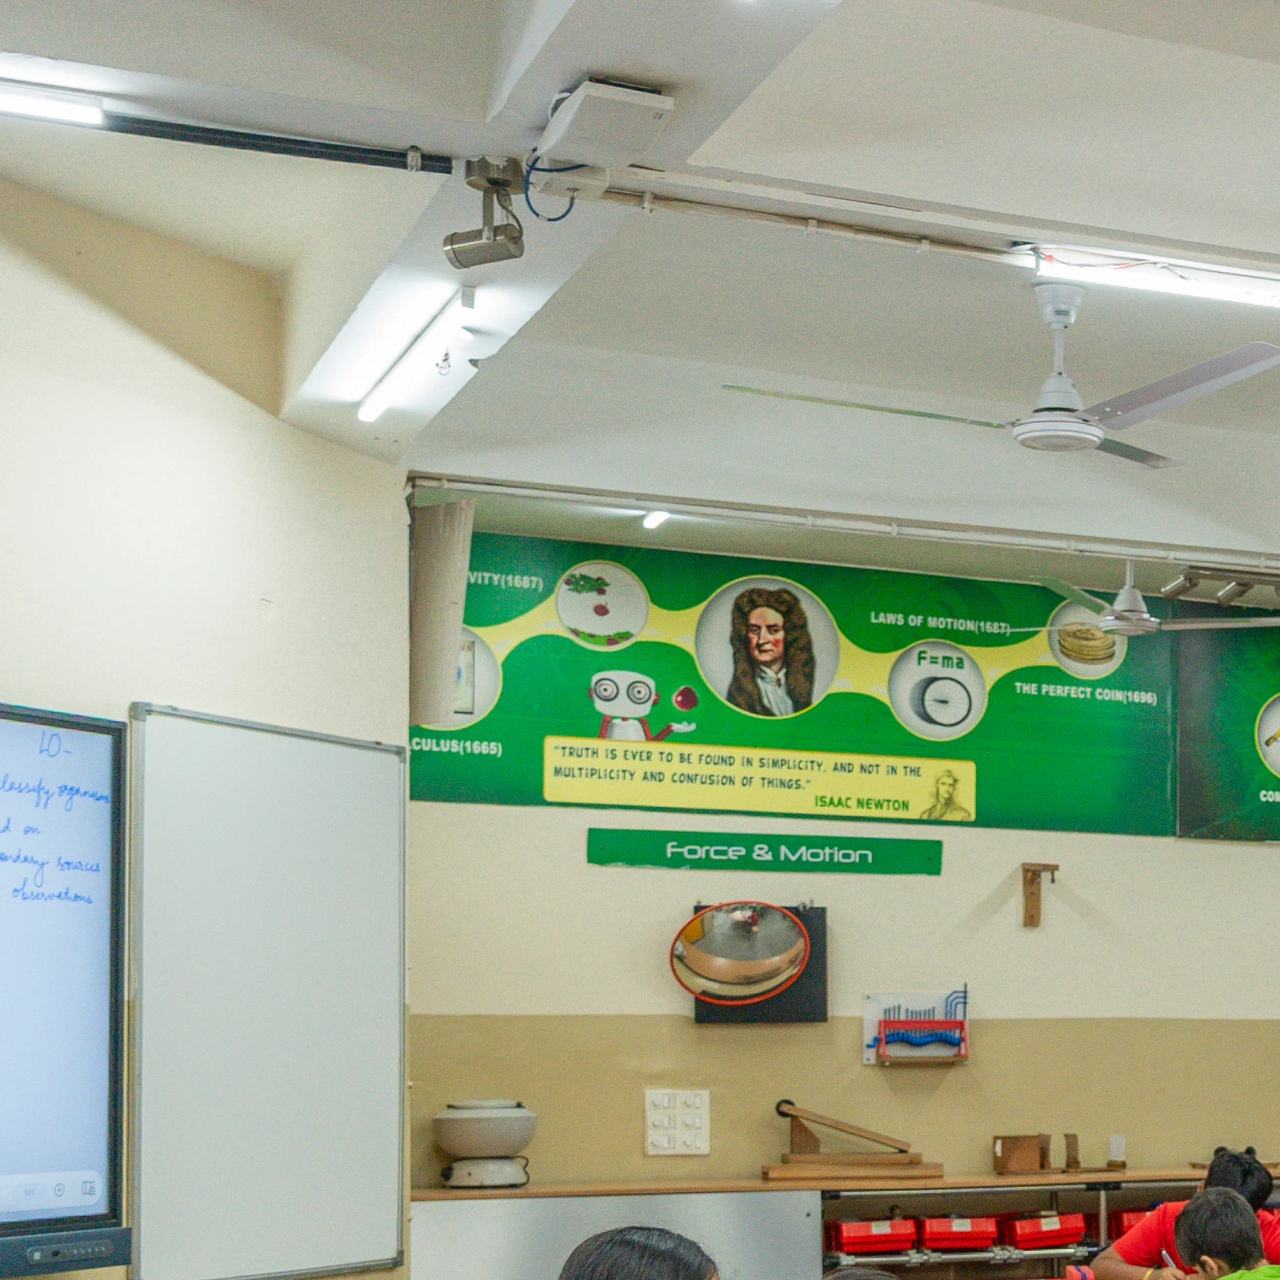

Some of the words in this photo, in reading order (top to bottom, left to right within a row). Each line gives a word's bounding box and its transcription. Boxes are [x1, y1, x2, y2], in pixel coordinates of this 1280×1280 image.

[870, 611, 905, 626] LAWS
[907, 614, 924, 627] OF
[928, 616, 1011, 636] MOTION(1687)
[917, 649, 965, 670] F=ma
[1014, 681, 1038, 695] THE
[1041, 683, 1093, 699] PERFECT
[1094, 687, 1158, 707] COIN(1696)
[554, 745, 599, 759] "TRUTH
[623, 749, 653, 762] EVER
[658, 751, 674, 764] TO
[678, 752, 693, 765] BE
[698, 753, 736, 767] FOUND
[832, 761, 855, 774] AND
[859, 763, 881, 775] NOT
[902, 765, 922, 778] THE
[642, 770, 666, 783] AND
[740, 775, 755, 788] OF
[814, 795, 852, 809] ISAAC
[856, 797, 910, 812] NEWTON
[665, 841, 746, 860] Force
[752, 843, 773, 861] &
[779, 844, 873, 863] Motion
